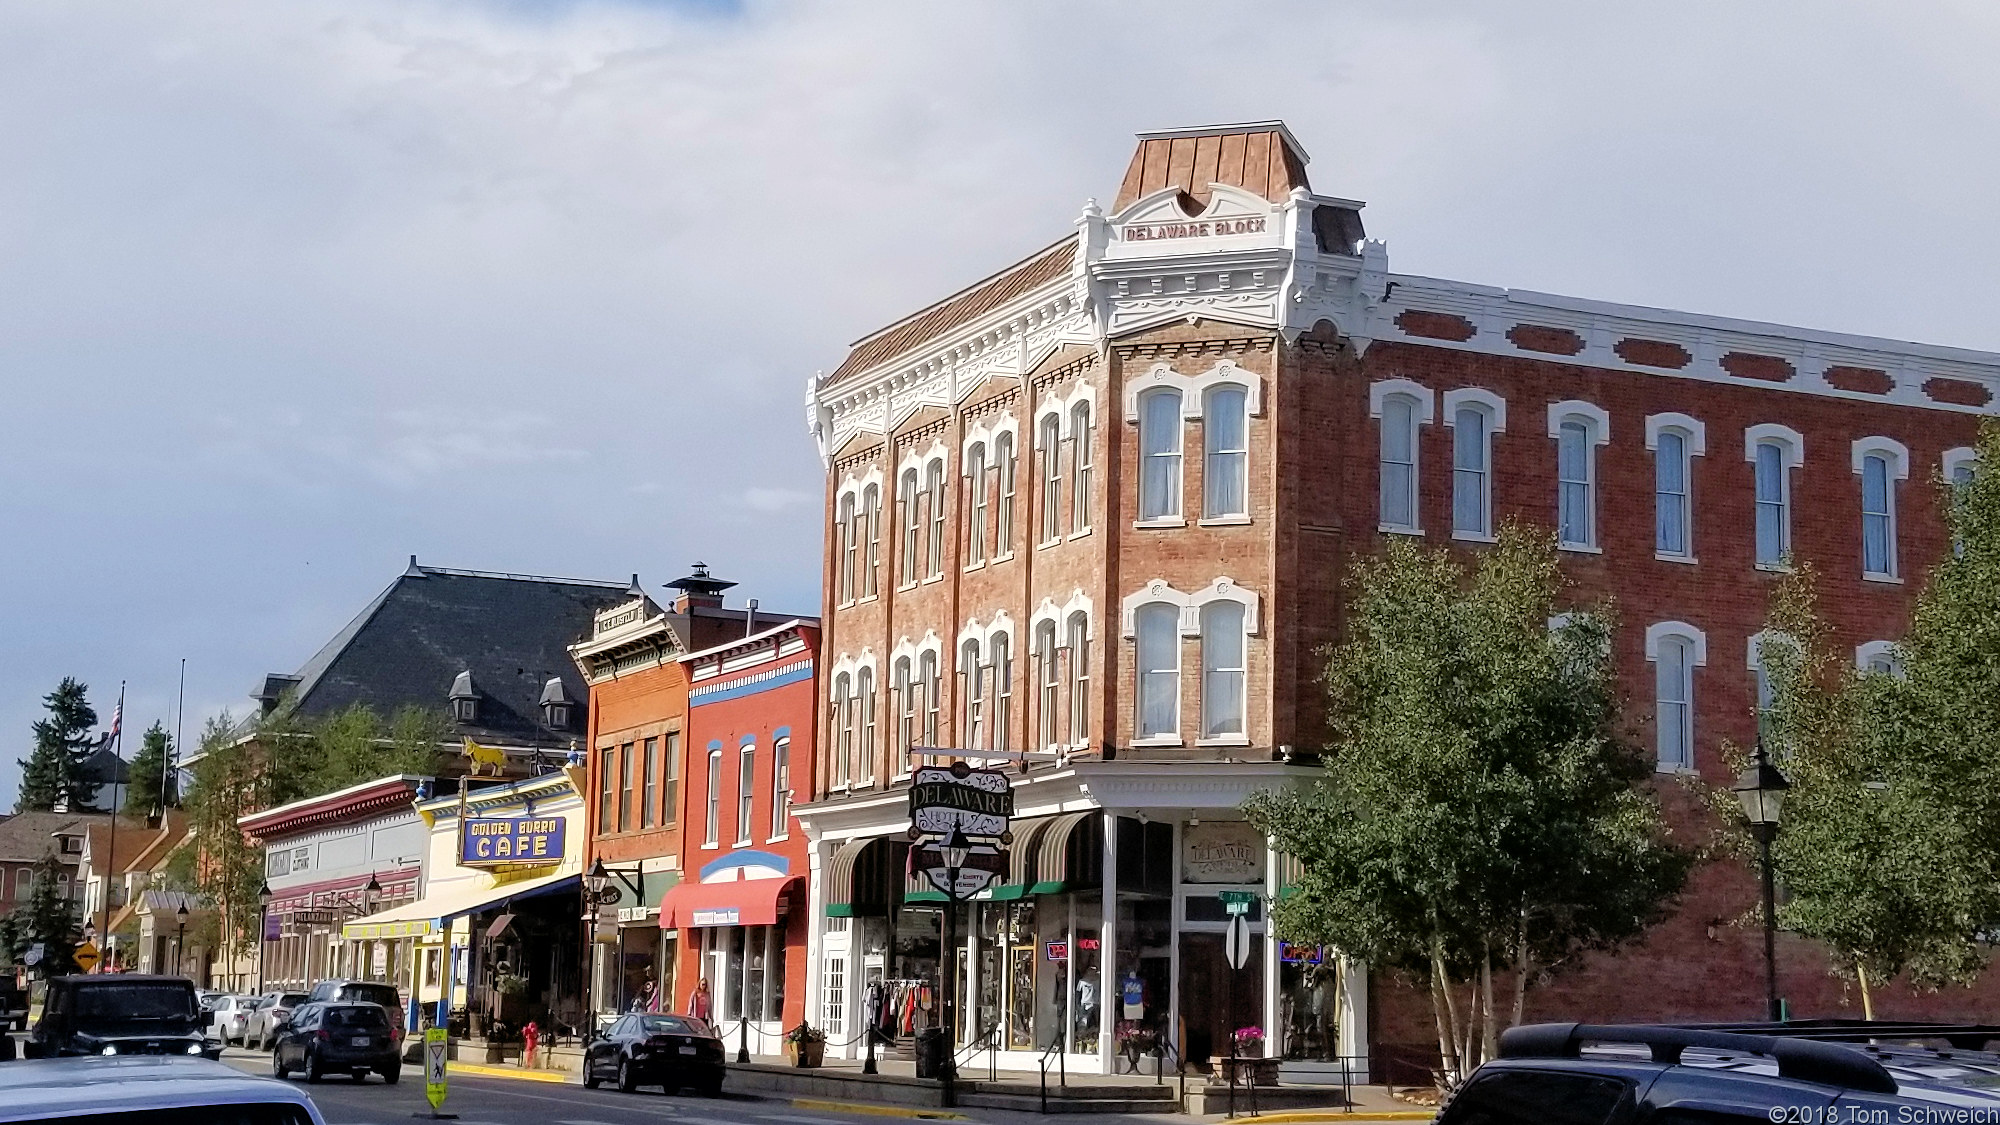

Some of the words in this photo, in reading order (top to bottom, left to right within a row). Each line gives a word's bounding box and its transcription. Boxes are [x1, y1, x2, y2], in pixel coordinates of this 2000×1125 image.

[1126, 223, 1211, 242] DELAWARE
[1214, 219, 1267, 236] BLOCK
[913, 785, 1011, 814] DELAWARE
[471, 822, 512, 836] GOLDEN
[518, 820, 556, 834] BURRO
[476, 835, 548, 858] CAFE
